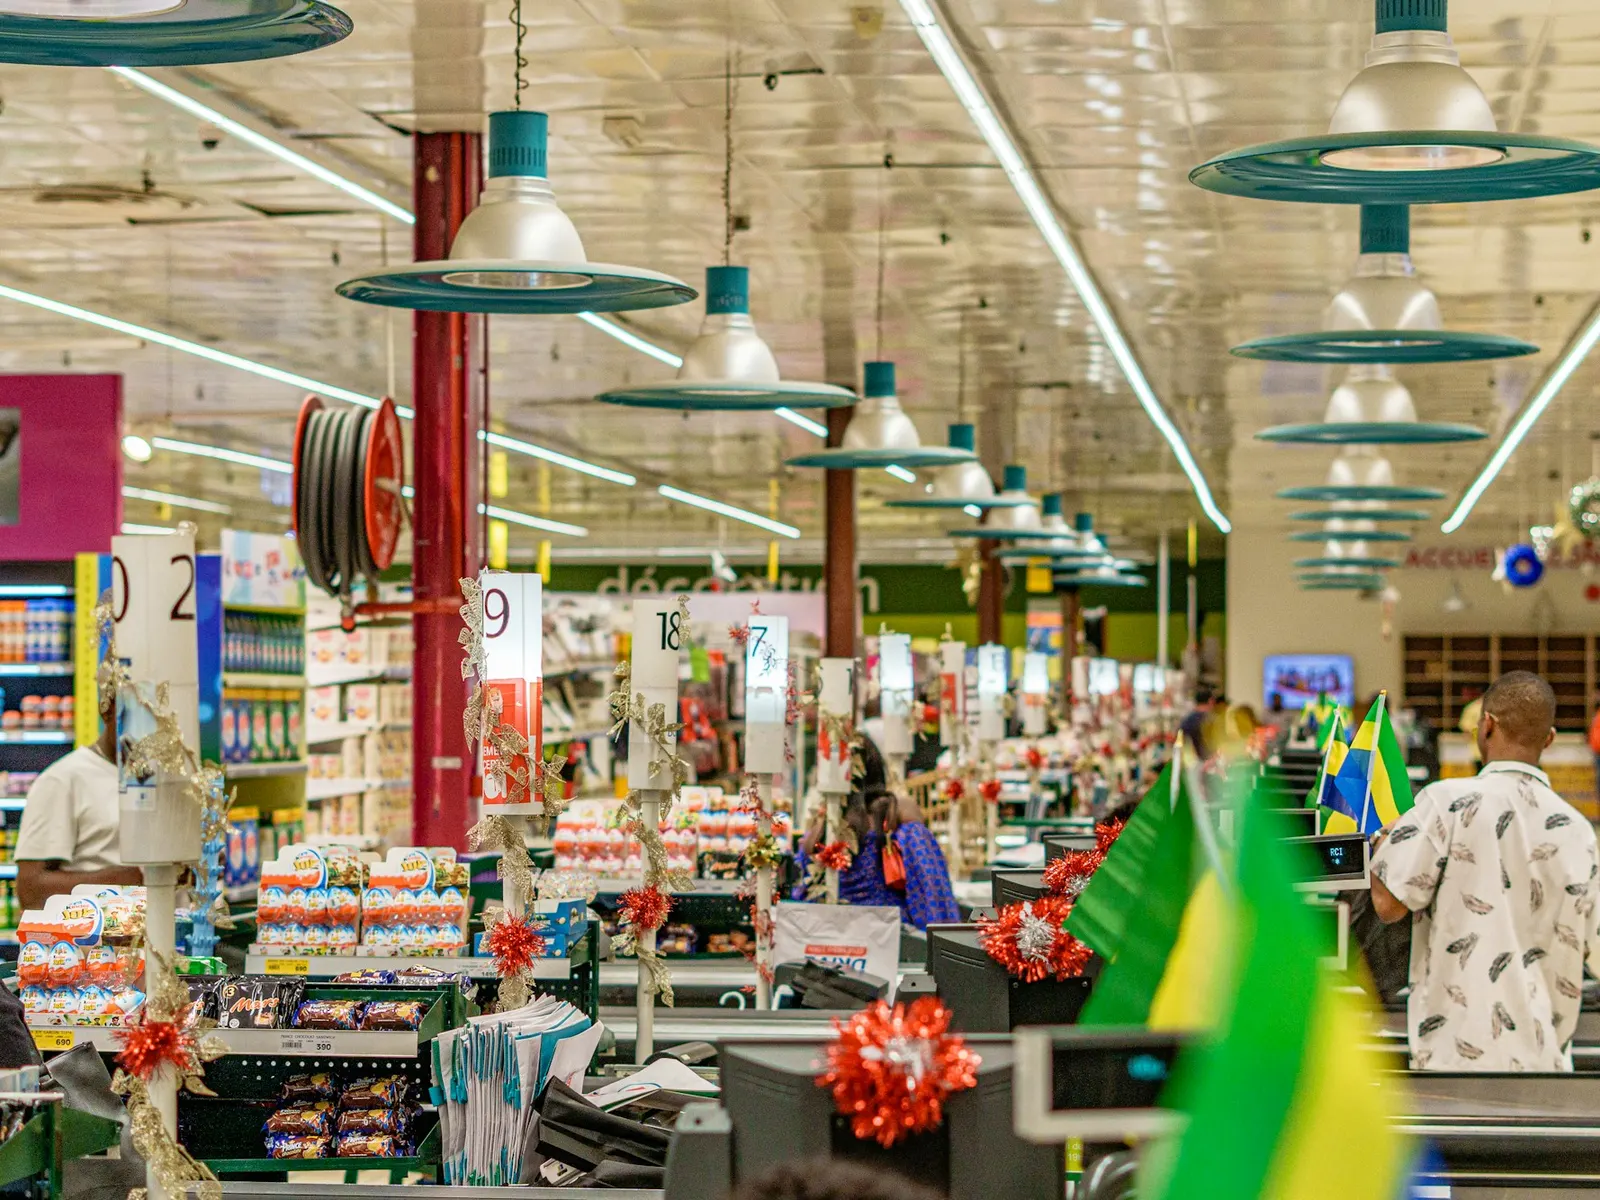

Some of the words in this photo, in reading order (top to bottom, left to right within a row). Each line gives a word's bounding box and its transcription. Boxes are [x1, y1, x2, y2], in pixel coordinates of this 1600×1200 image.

[170, 554, 195, 620] 2
[656, 611, 681, 650] 18
[229, 997, 280, 1014] Mars
[316, 1043, 332, 1051] 390
